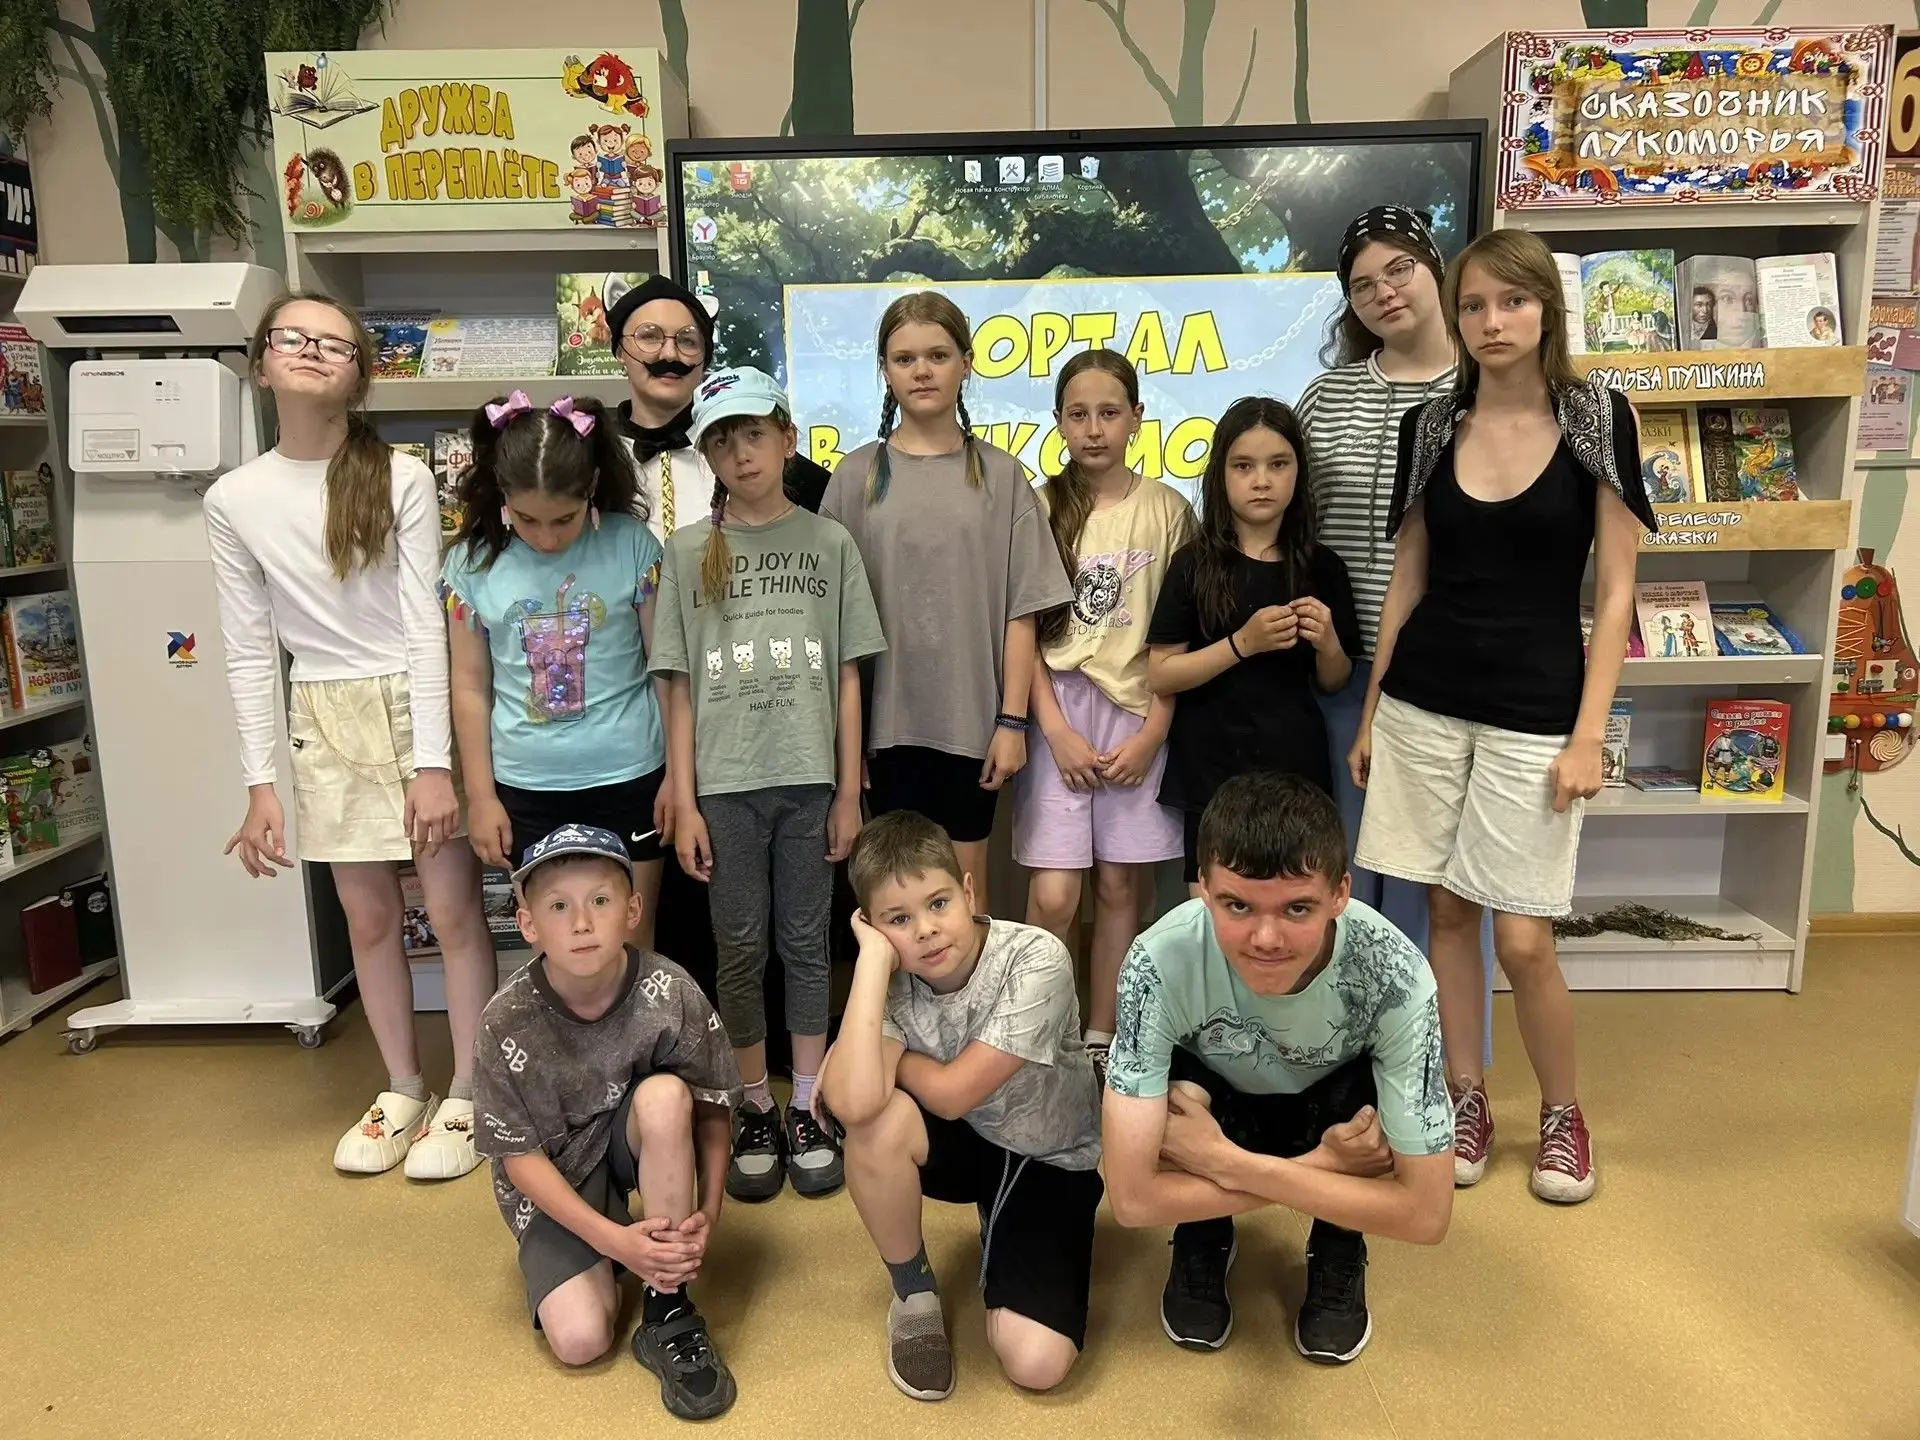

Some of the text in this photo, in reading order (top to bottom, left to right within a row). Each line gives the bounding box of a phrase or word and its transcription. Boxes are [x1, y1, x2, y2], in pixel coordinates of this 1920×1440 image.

[1580, 88, 1827, 119] СКАЗОЧНИК
[380, 82, 515, 153] ДРУЖБА
[1579, 128, 1826, 159] ЛУКОМОРЬЯ
[353, 147, 561, 201] В ПЕРЕПЛЁТЕ
[971, 311, 1229, 379] ОРТАЛ
[1667, 362, 1765, 390] ПУШКИНА
[1654, 512, 1742, 527] РЕЛЕСТЬ
[1643, 531, 1718, 545] СКАЗКИ
[755, 552, 793, 572] JOY
[798, 552, 820, 571] IN
[759, 575, 828, 598] THINGS
[722, 607, 804, 622] Quick guide for foodies
[749, 698, 795, 711] HAVE FUN!
